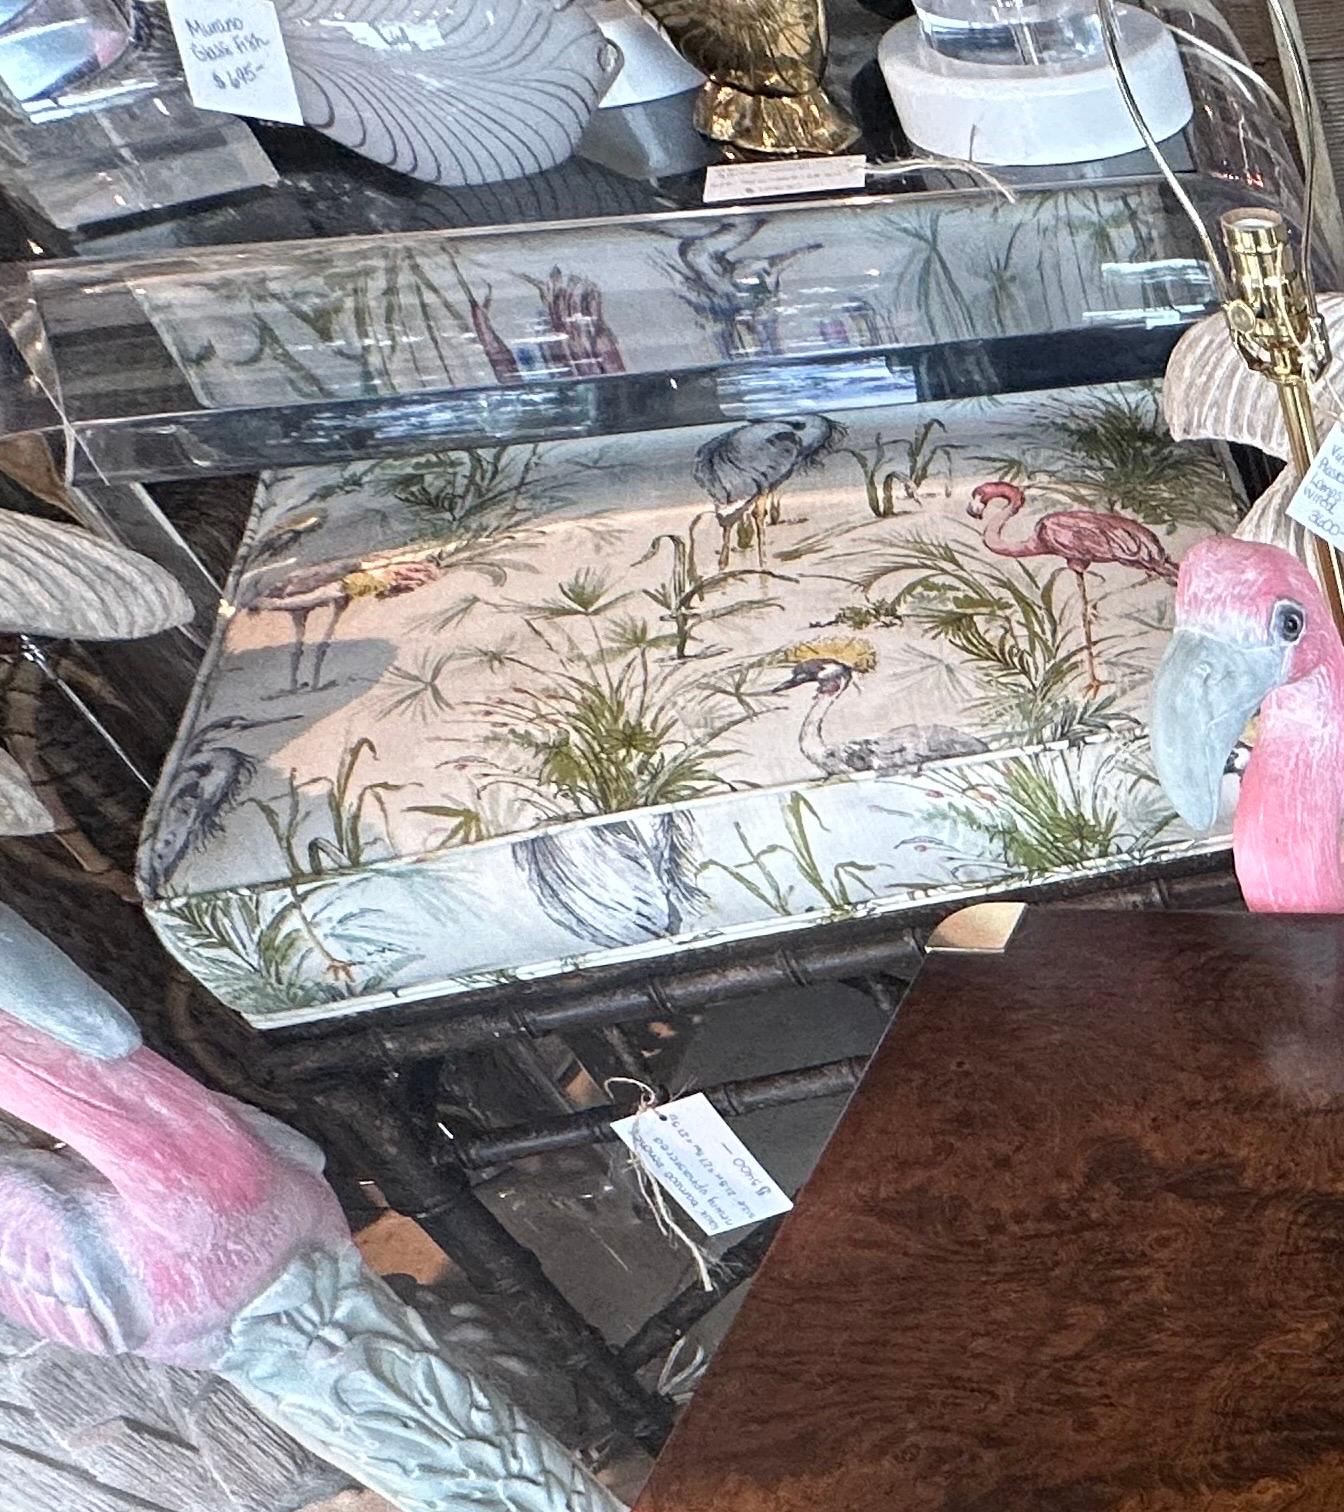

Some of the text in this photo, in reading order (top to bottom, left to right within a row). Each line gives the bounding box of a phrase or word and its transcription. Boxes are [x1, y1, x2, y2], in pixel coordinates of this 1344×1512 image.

[185, 18, 243, 38] Murano
[190, 33, 270, 61] Glass Fish
